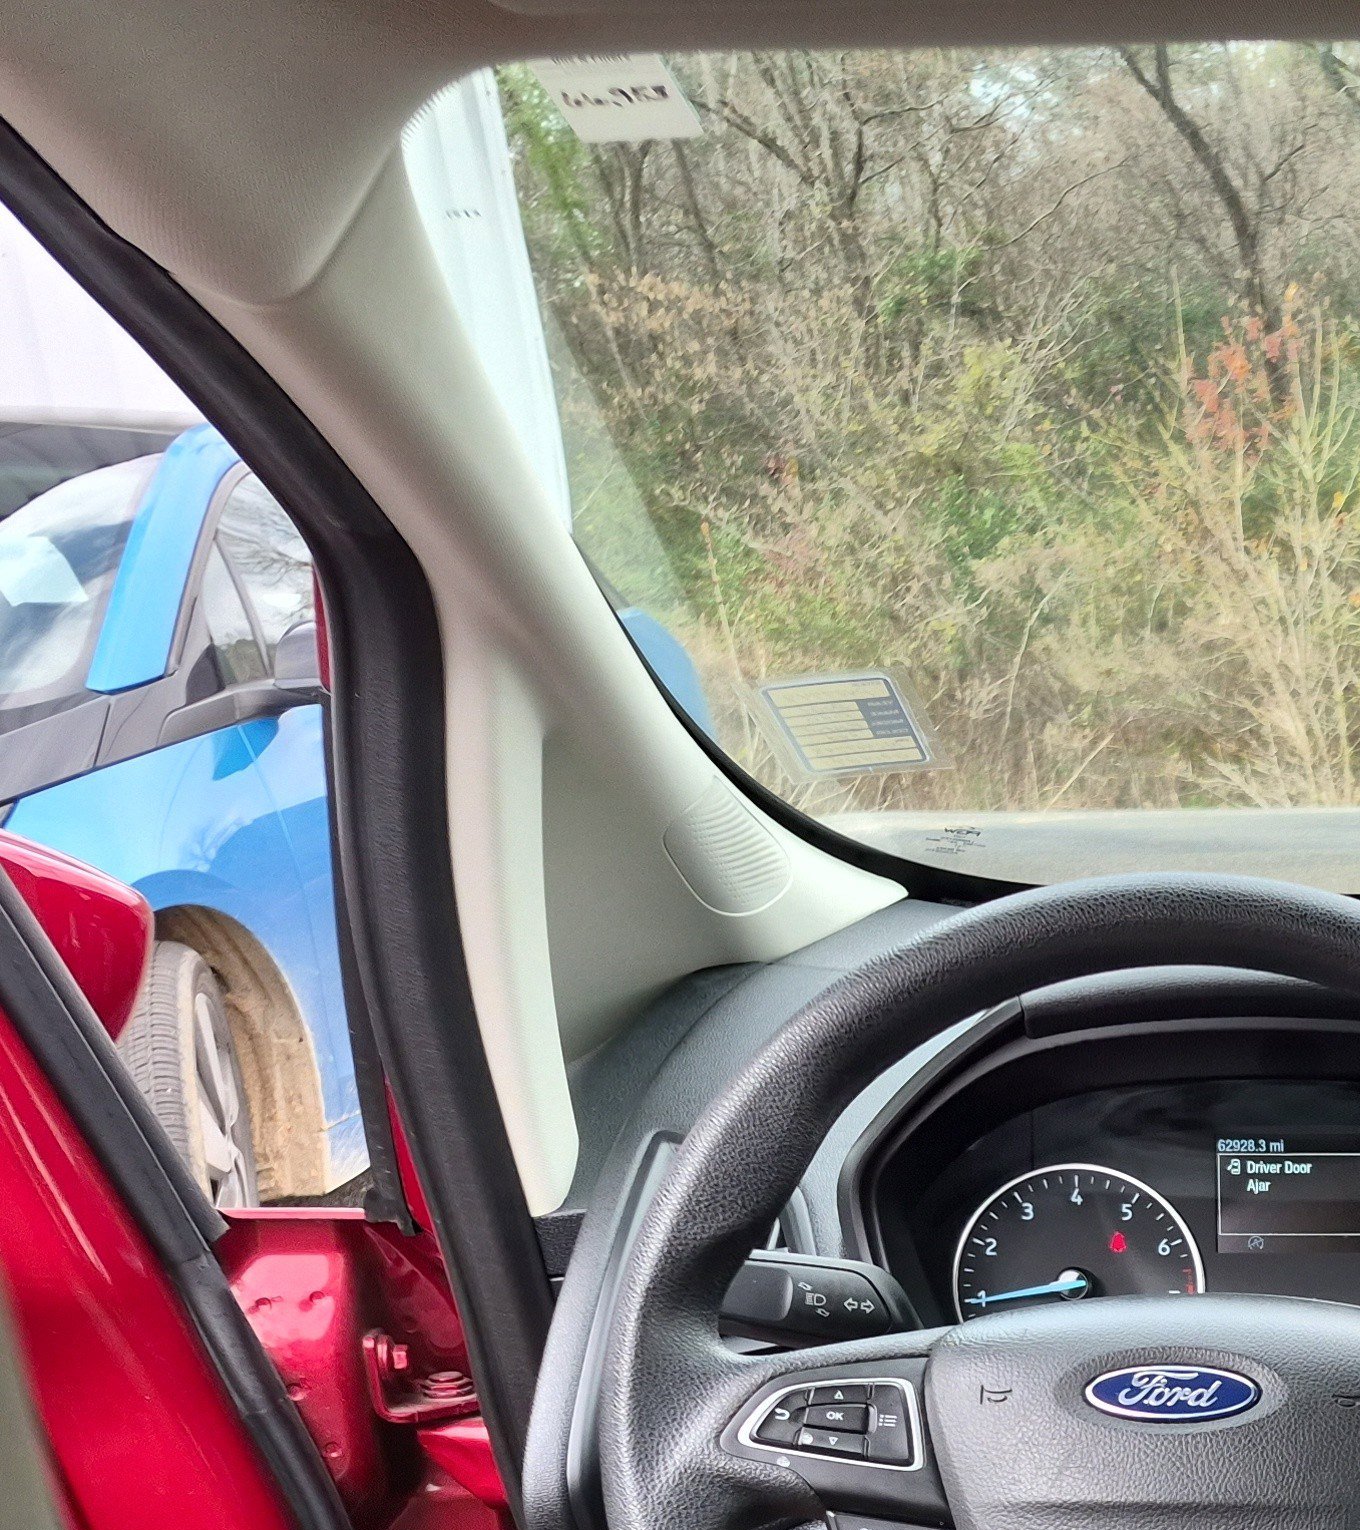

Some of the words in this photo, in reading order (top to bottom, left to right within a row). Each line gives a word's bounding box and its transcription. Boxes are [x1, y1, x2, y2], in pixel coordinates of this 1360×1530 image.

[1217, 1139, 1267, 1152] 62928.3
[1269, 1139, 1285, 1152] mi
[1246, 1160, 1282, 1174] Driver
[1284, 1160, 1313, 1174] Door
[1246, 1178, 1271, 1195] Ajar
[1070, 1188, 1083, 1205] 4
[1021, 1202, 1034, 1221] 3
[1121, 1204, 1133, 1221] 5
[985, 1238, 997, 1256] 2
[1158, 1238, 1171, 1256] 6
[1118, 1370, 1222, 1407] Ford
[826, 1411, 844, 1421] OK
